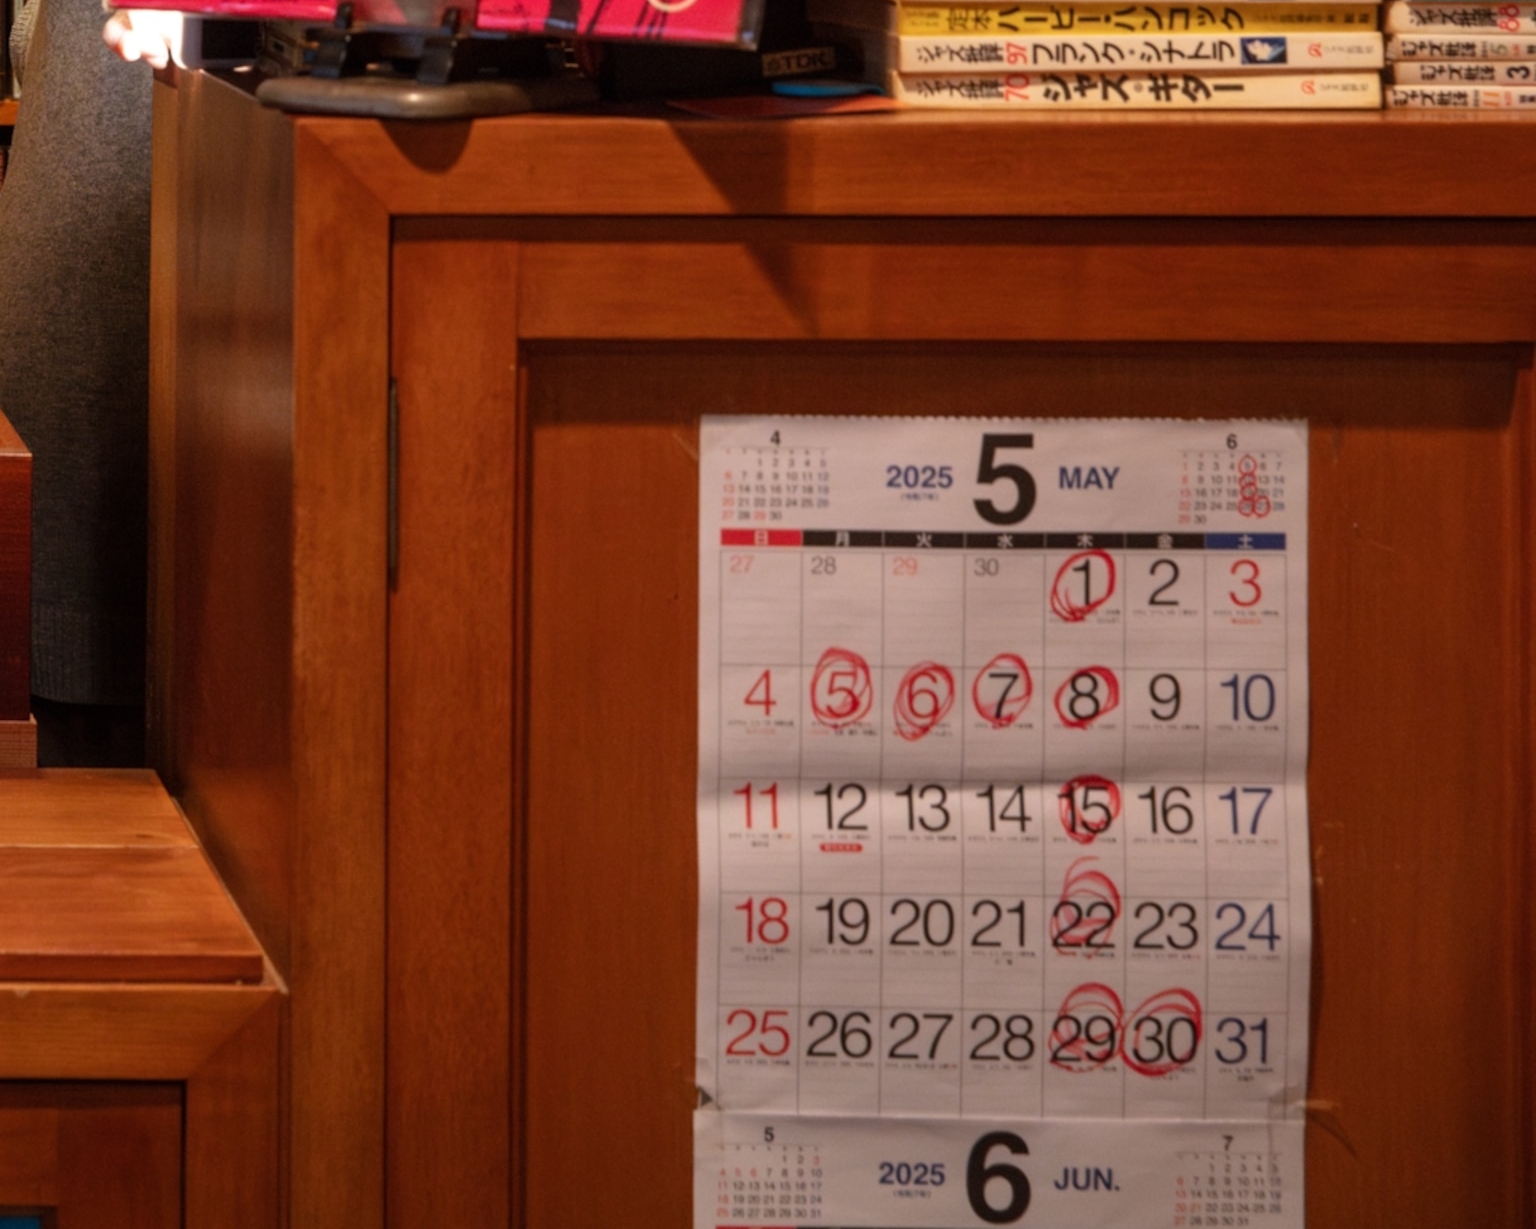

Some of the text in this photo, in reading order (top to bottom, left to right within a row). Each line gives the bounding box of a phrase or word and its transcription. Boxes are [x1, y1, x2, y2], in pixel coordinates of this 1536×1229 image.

[997, 5, 1245, 33] ハービー・ハンコック
[1497, 4, 1521, 32] 88
[783, 52, 830, 71] TDK
[917, 39, 1235, 65] ジャズ批評 97 フランク・シナトラ
[1506, 65, 1531, 80] 3
[916, 72, 1245, 103] ジャズ批評 70 ジャズ・ギター
[1482, 90, 1501, 108] 11
[770, 429, 782, 446] 4
[1226, 433, 1238, 451] 6
[885, 433, 1121, 527] 2025 5 MAY
[916, 532, 932, 549] 火
[996, 532, 1013, 549] 水
[1076, 533, 1093, 549] 木
[1237, 534, 1254, 550] 土
[729, 556, 1262, 607] 27 28 29 30 1 2 3
[744, 670, 1276, 721] 4 5 6 7 8 9 10
[734, 783, 1273, 835] 11 12 13 14 15 16 17
[735, 898, 1281, 951] 18 19 20 21 22 23 24
[725, 1010, 1270, 1064] 25 26 27 28 29 30 31
[764, 1126, 775, 1143] 5
[1222, 1134, 1234, 1152] 7
[878, 1130, 1121, 1225] 2025 6 JUN.
